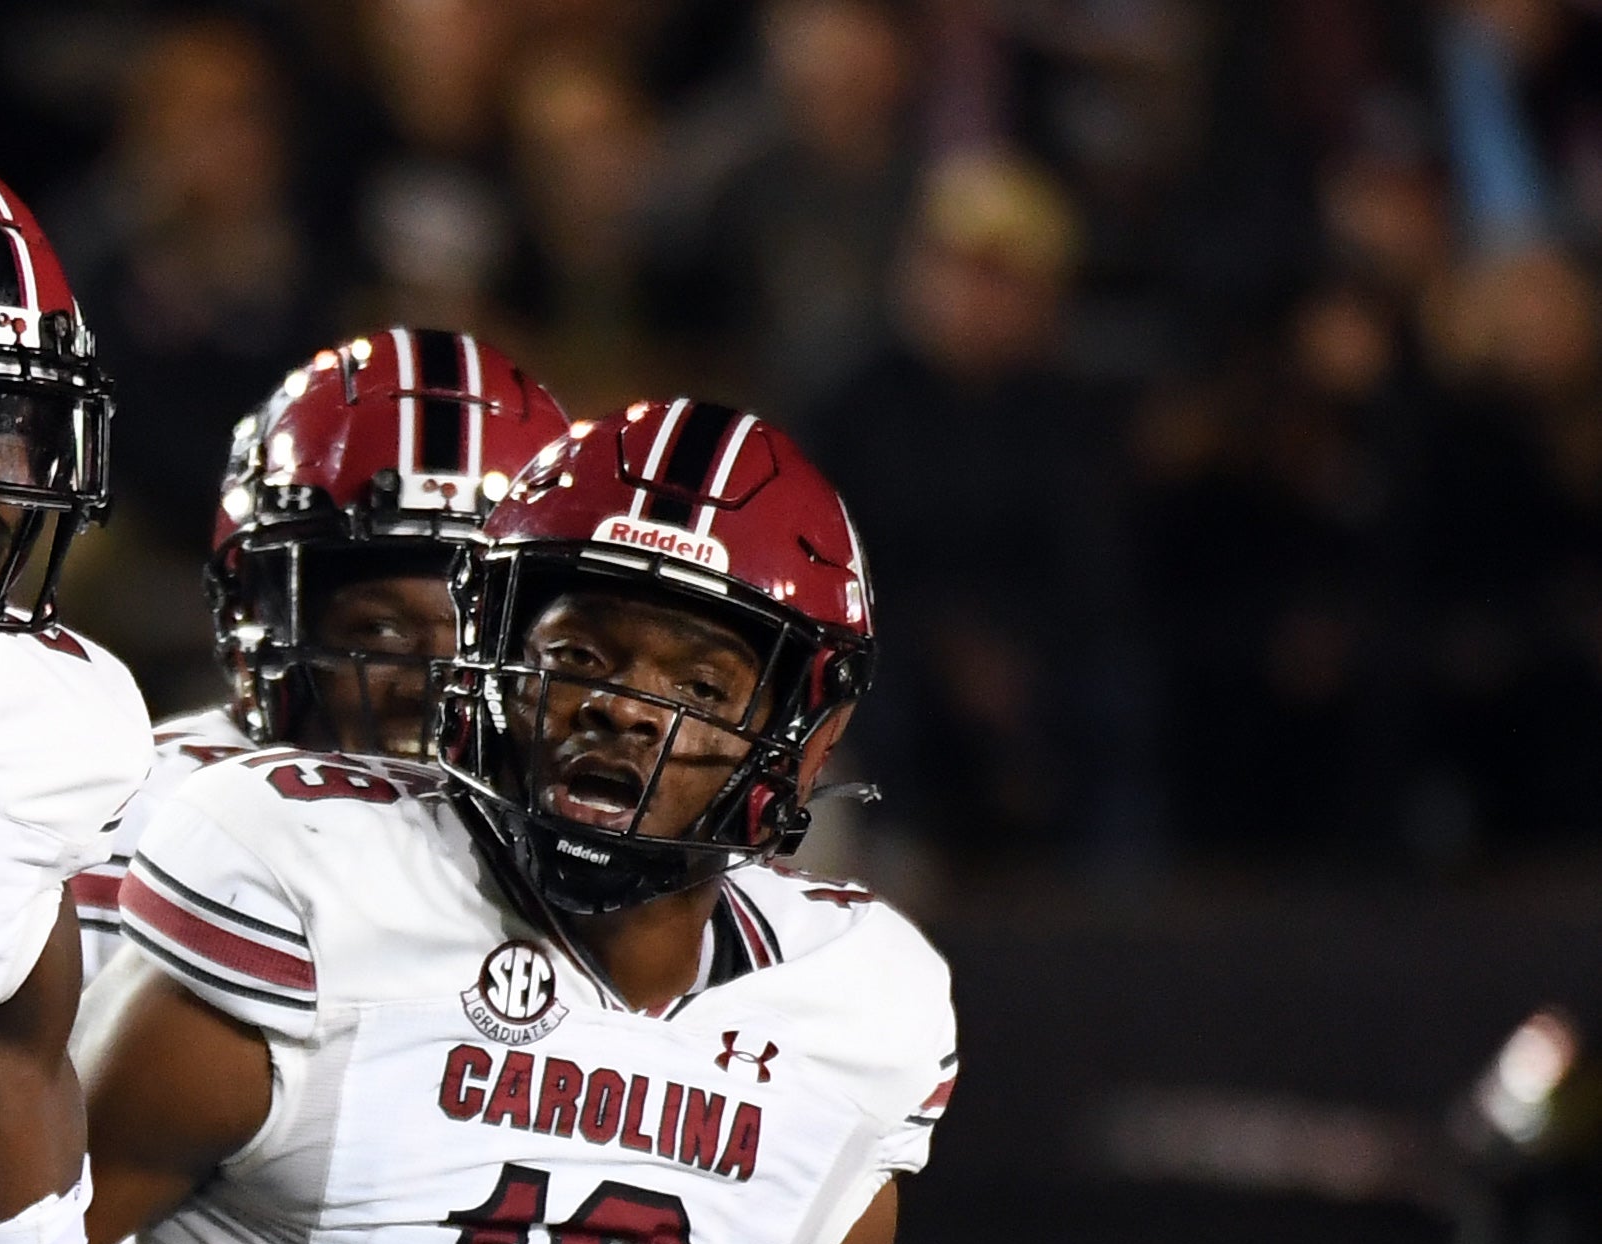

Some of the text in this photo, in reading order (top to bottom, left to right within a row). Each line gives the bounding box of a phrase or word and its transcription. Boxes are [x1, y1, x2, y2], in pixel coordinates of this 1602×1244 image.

[609, 522, 715, 564] Riddell
[556, 839, 611, 868] Riddell
[486, 946, 552, 1019] SEC
[471, 1005, 552, 1044] GRADUATE
[437, 1043, 763, 1183] CAROLINA
